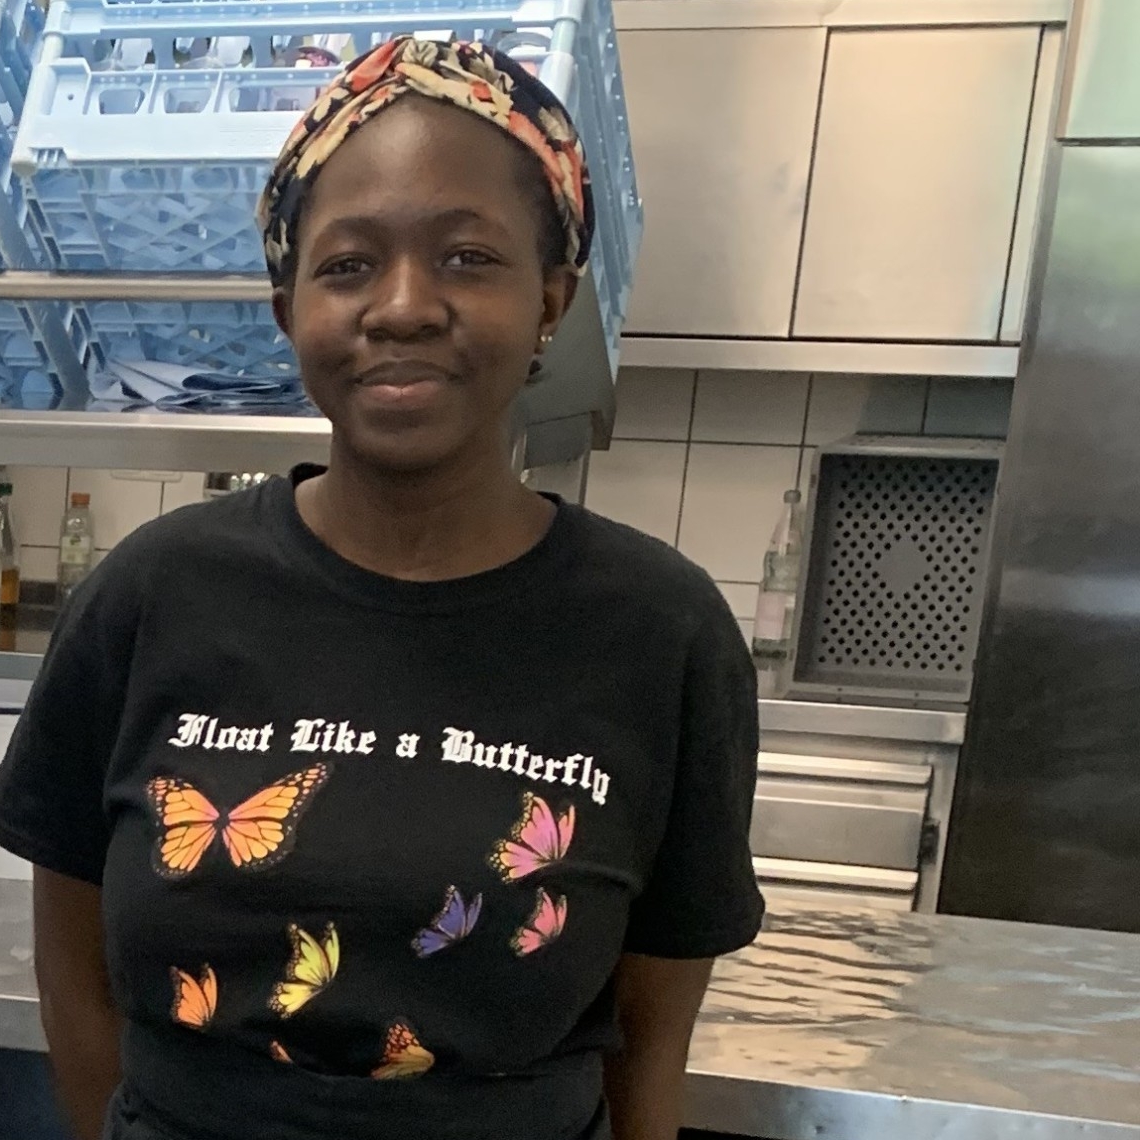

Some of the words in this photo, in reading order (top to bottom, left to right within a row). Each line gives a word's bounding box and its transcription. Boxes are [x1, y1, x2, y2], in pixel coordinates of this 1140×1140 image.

[168, 713, 274, 752] Float
[290, 718, 377, 754] Like
[395, 732, 421, 759] a
[442, 726, 611, 805] Butterfly
